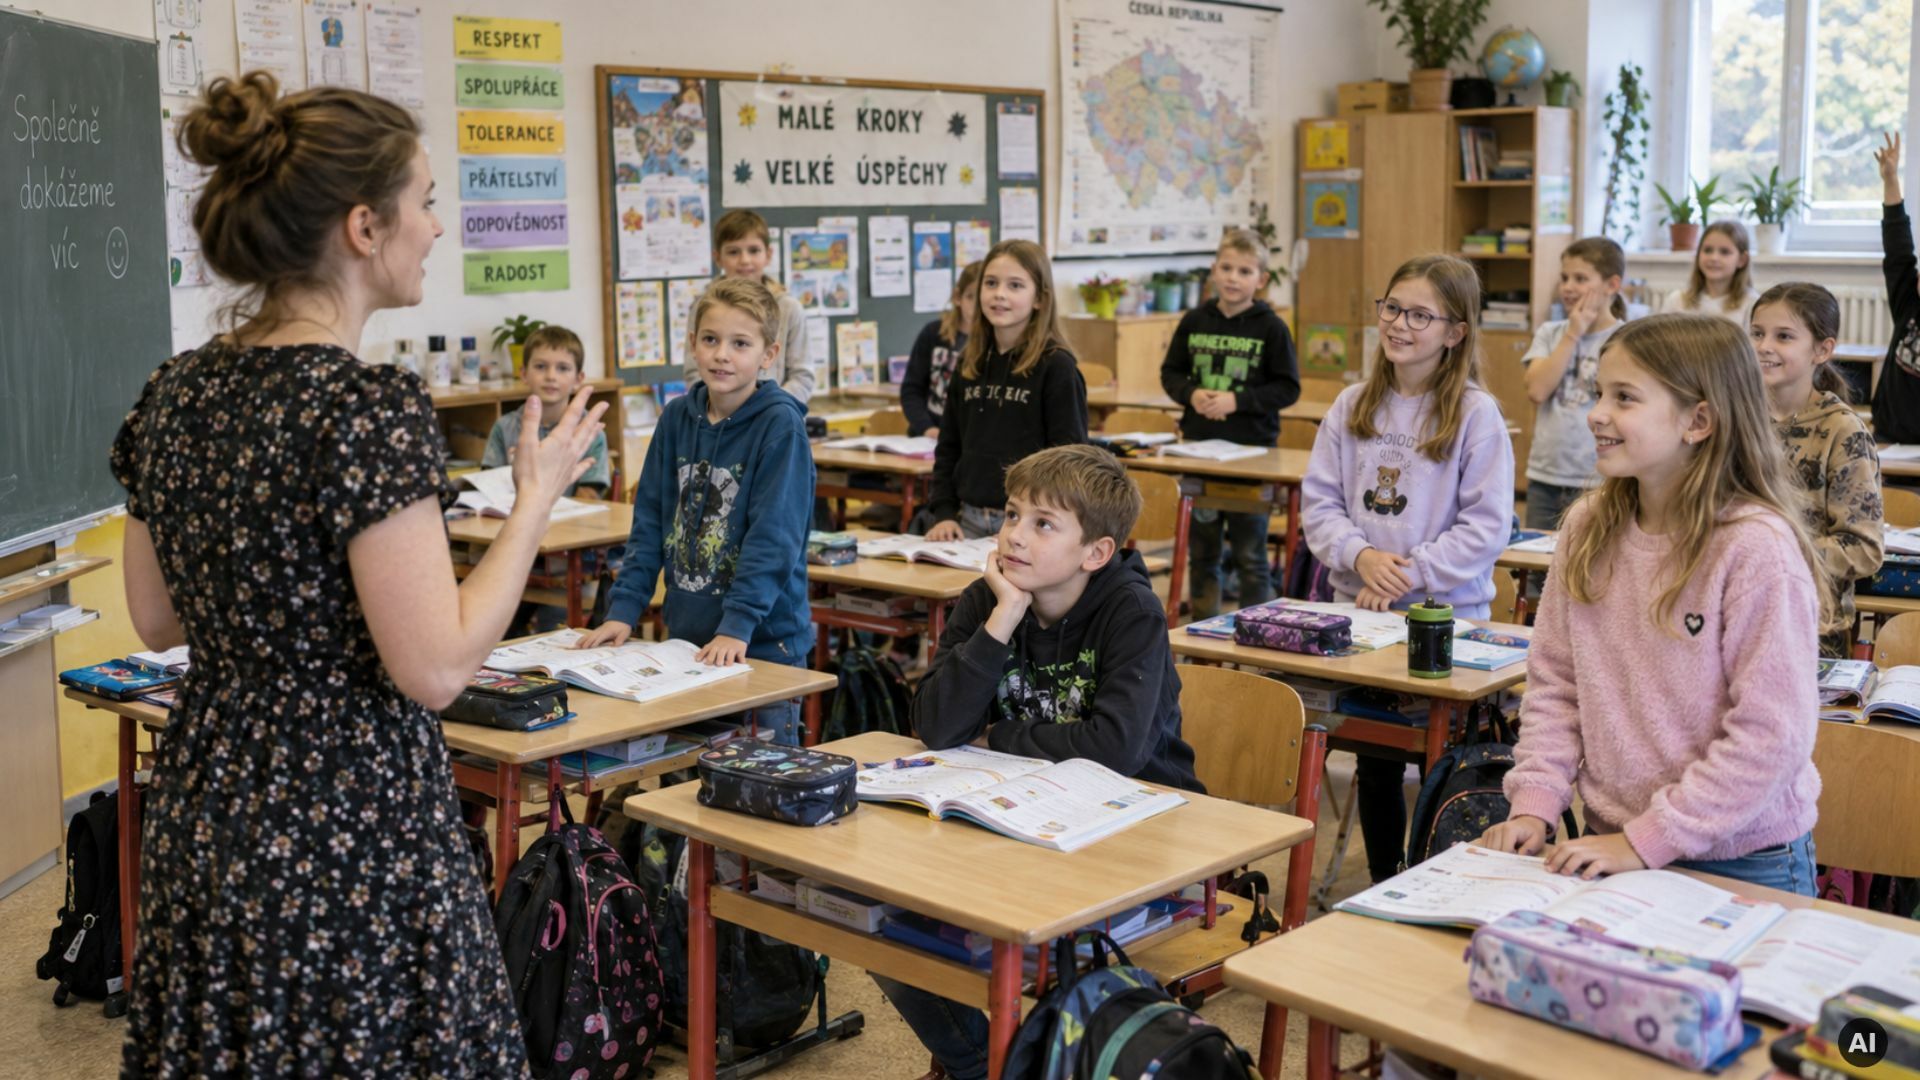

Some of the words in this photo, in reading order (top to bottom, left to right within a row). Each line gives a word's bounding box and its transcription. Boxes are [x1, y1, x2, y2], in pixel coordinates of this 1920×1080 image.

[1168, 6, 1224, 23] REPUBLIKA
[473, 29, 542, 49] RESPEKT
[13, 94, 101, 159] Společně
[778, 100, 835, 131] MALÉ
[857, 108, 923, 133] KROKY
[466, 125, 555, 142] TOLERANCE
[469, 167, 558, 188] PŘÁTELSTVÍ
[766, 154, 835, 185] VELKÉ
[857, 154, 948, 185] ÚSPĚCHY
[20, 165, 116, 209] dokážeme
[50, 226, 80, 269] víc
[484, 263, 547, 283] RADOST
[1188, 334, 1264, 354] MINECRAFT
